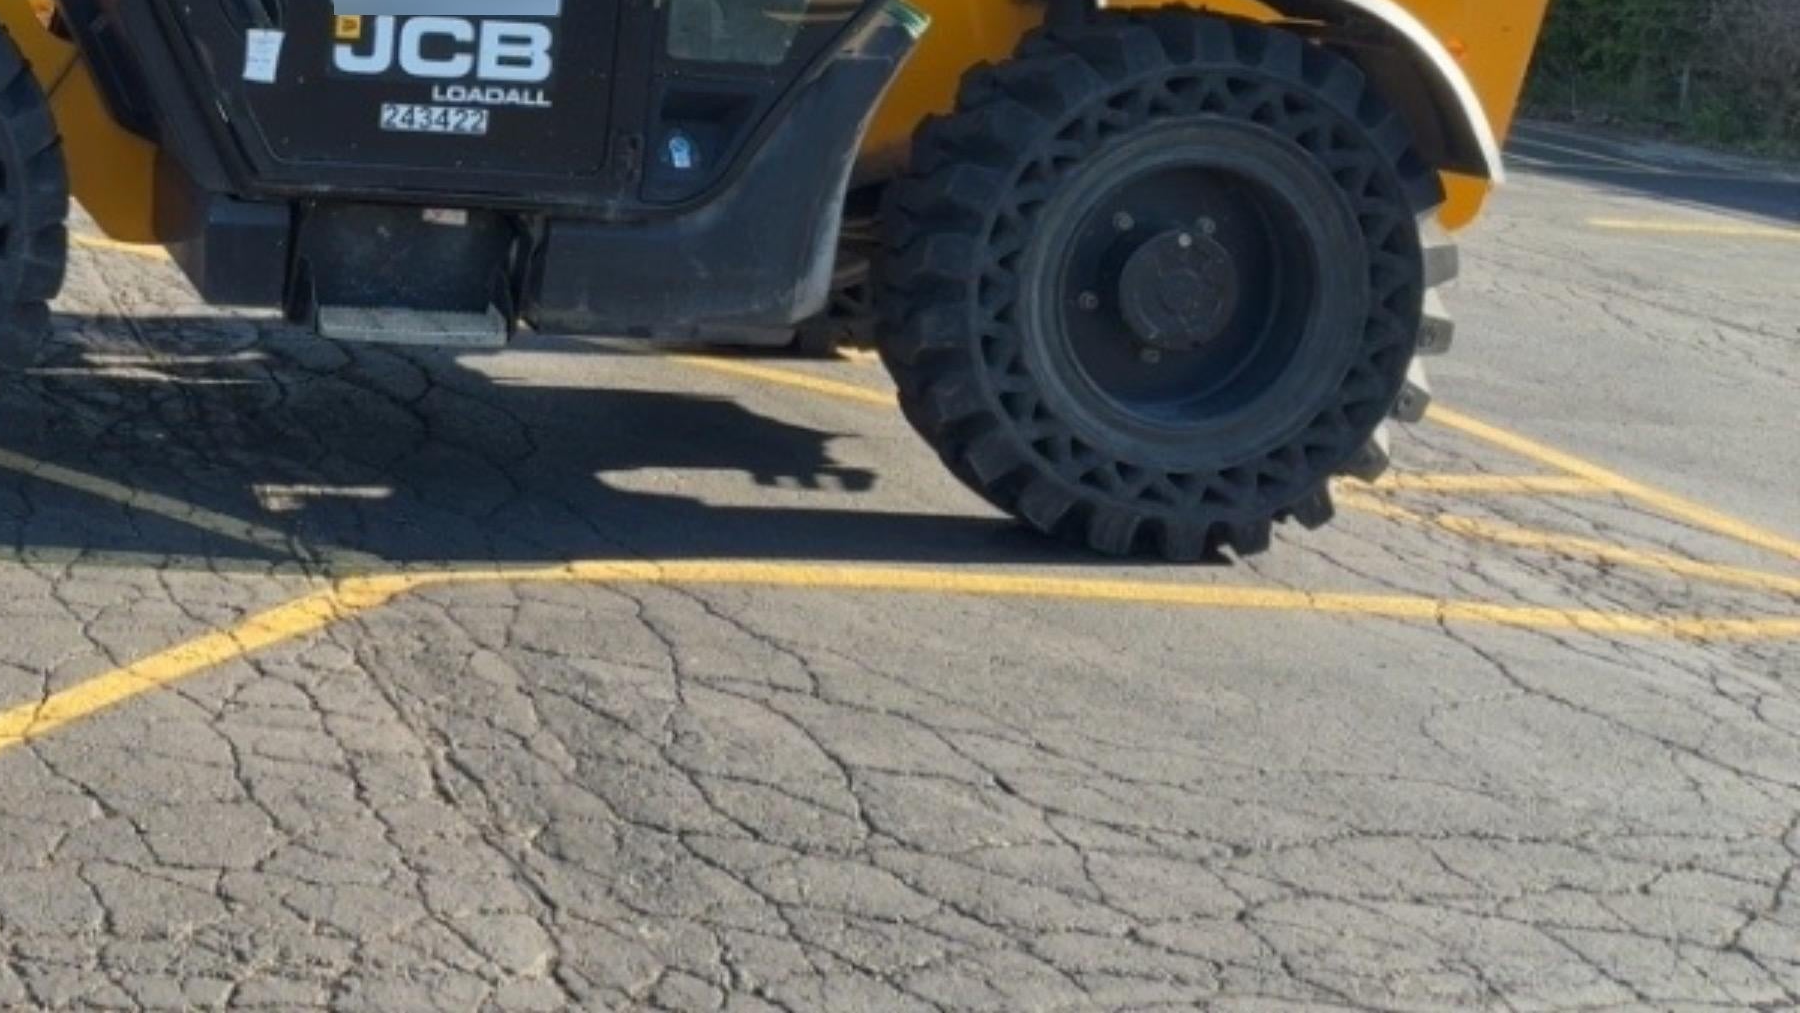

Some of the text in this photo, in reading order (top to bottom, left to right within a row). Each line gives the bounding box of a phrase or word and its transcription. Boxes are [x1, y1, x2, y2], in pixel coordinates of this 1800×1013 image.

[333, 15, 552, 82] JCB
[432, 85, 552, 107] LOADALL
[384, 105, 485, 133] 243422
